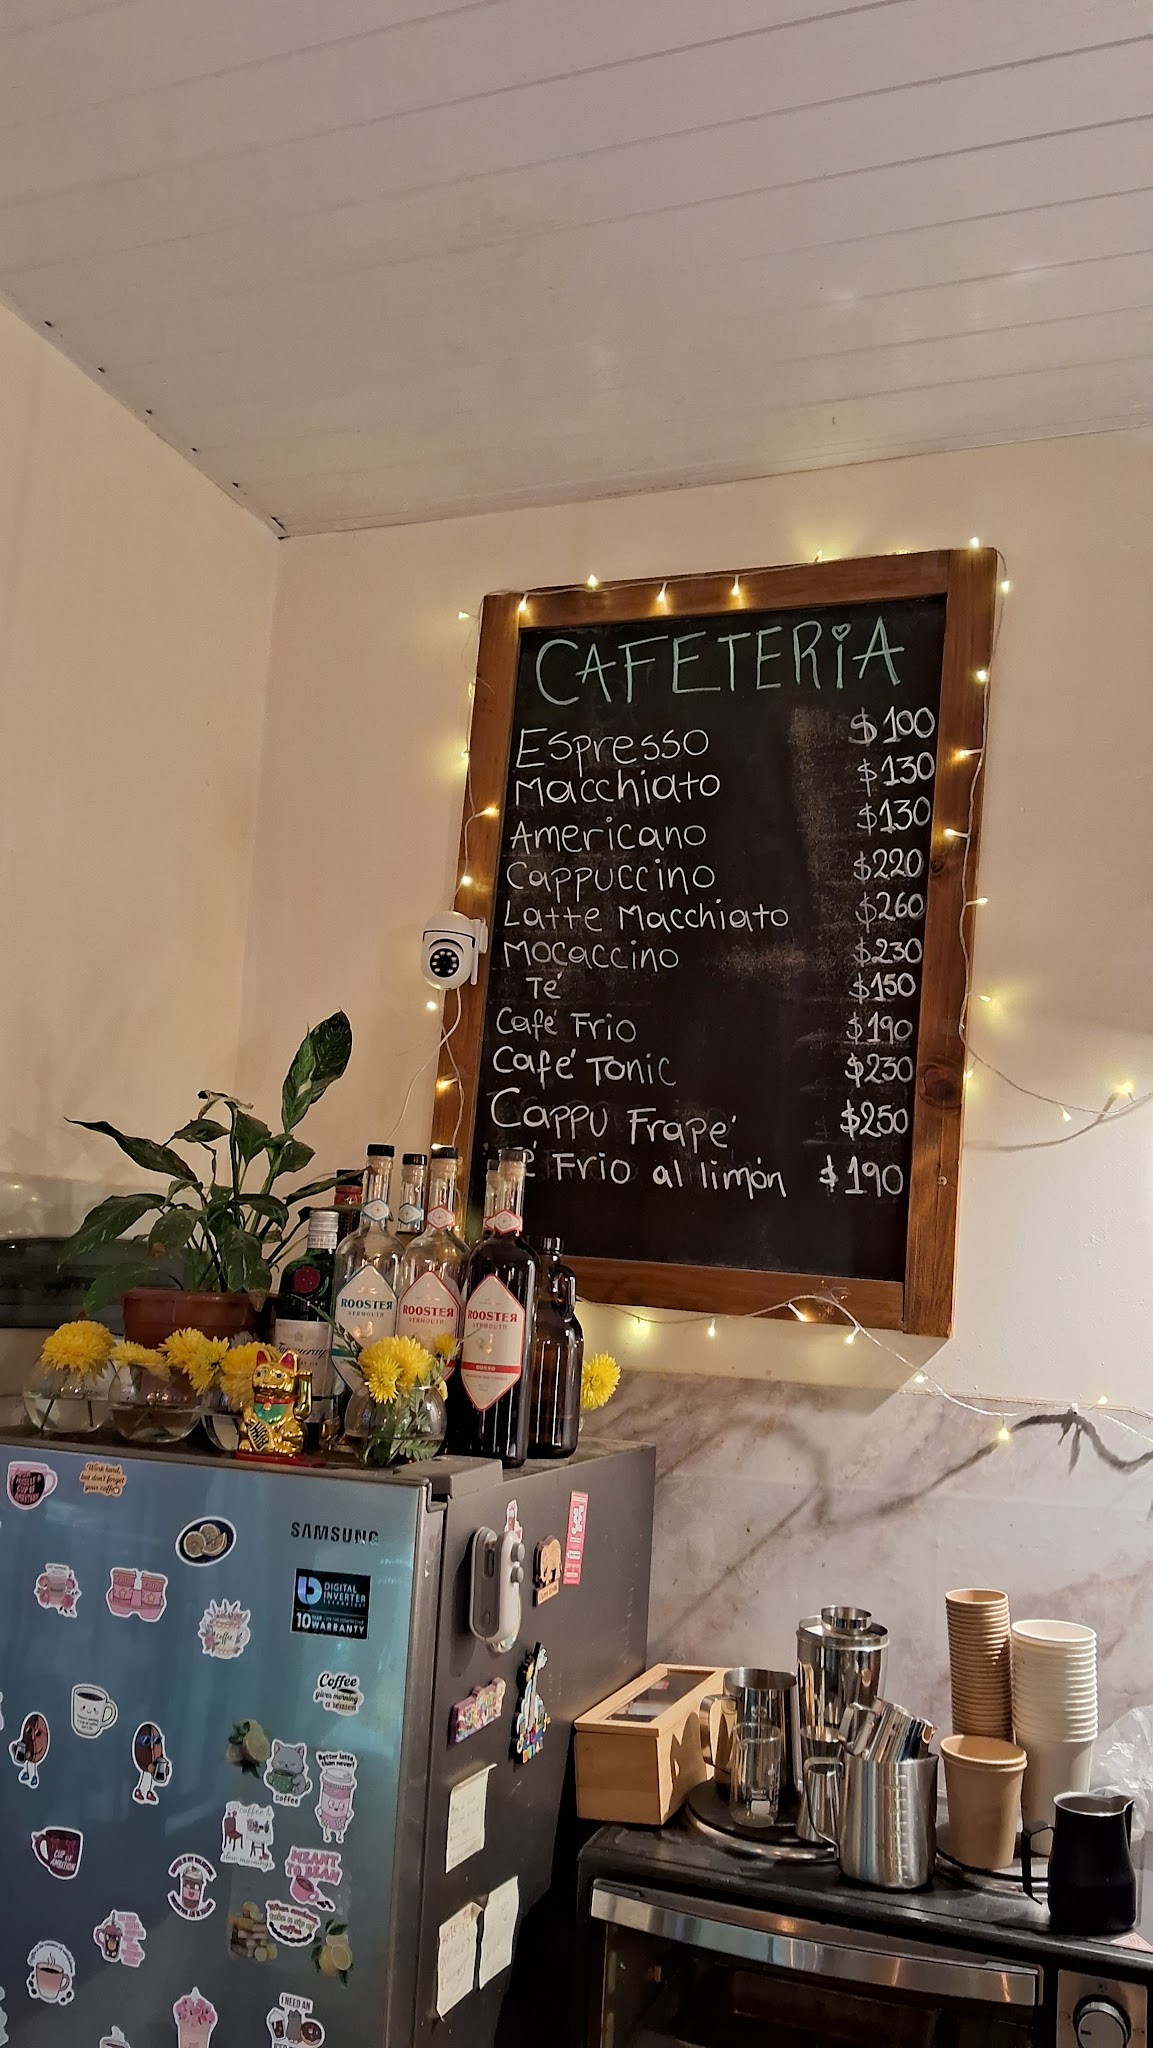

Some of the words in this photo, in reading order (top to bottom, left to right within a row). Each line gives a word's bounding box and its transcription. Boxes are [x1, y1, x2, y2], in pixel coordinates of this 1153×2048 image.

[514, 727, 709, 777] Espresso
[848, 705, 936, 747] $100
[515, 769, 720, 807] Macchiato
[857, 752, 936, 797] $130
[510, 816, 707, 855] Americano
[857, 796, 931, 836] $130
[506, 858, 715, 902] Cappuccino
[853, 848, 924, 885] $220
[504, 901, 603, 931] Latte
[619, 899, 789, 934] Macchiato
[855, 891, 926, 933] $260
[853, 937, 922, 967] $230
[525, 972, 561, 1000] Té
[849, 972, 916, 1005] $150
[496, 1006, 558, 1041] Café
[570, 1013, 637, 1043] Frio
[846, 1011, 913, 1045] $190
[493, 1045, 577, 1089] Café
[586, 1055, 676, 1087] Tonic
[845, 1052, 913, 1088] $230
[490, 1087, 608, 1140] Cappu
[628, 1107, 737, 1154] Frapé
[840, 1099, 908, 1141] $250
[552, 1151, 631, 1185] Frio
[652, 1159, 703, 1189] al
[700, 1157, 787, 1200] limón
[290, 1521, 379, 1544] SAMSUNG
[323, 1591, 366, 1603] INVERTER
[324, 1581, 357, 1593] DIGITAL
[296, 1612, 311, 1629] 10
[312, 1620, 364, 1634] WARRANTY
[319, 1673, 357, 1690] Coffee
[275, 1794, 298, 1805] coffee
[53, 1849, 66, 1859] CUP
[290, 1850, 339, 1867] MEANT
[50, 1860, 76, 1872] AMBITION
[286, 1863, 302, 1875] TO
[304, 1865, 340, 1883] BEAN
[285, 1996, 301, 2008] NEED
[301, 2001, 311, 2010] AN
